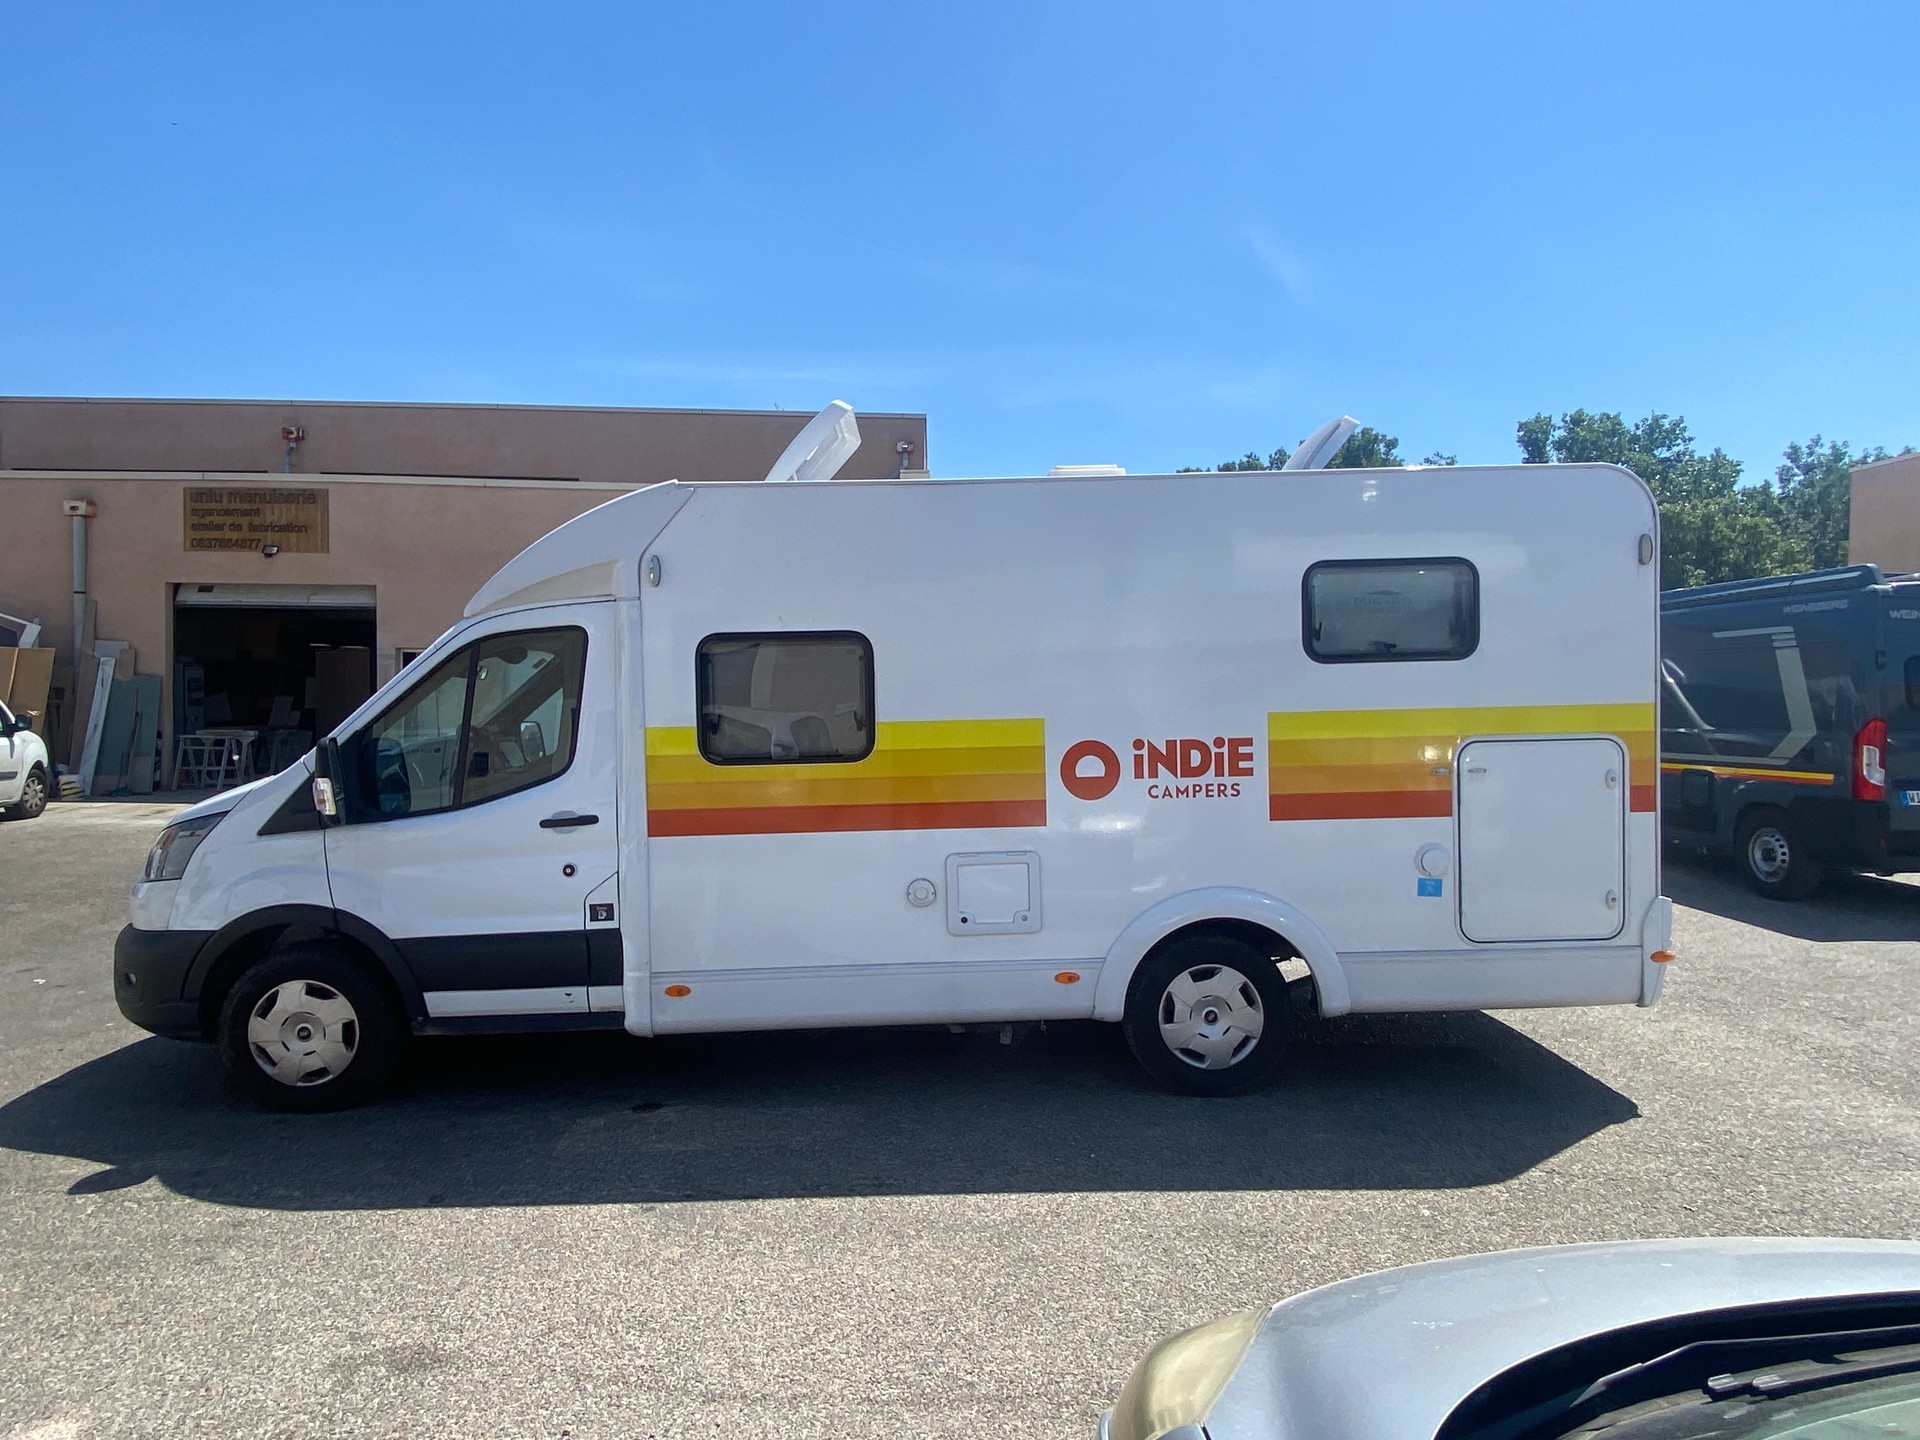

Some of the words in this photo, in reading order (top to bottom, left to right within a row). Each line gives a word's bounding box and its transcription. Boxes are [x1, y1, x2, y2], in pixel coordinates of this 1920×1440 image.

[191, 507, 261, 518] agencement
[191, 521, 226, 532] atelier
[228, 522, 243, 532] de
[248, 522, 308, 534] fabrication
[1147, 783, 1241, 799] CAMPERS
